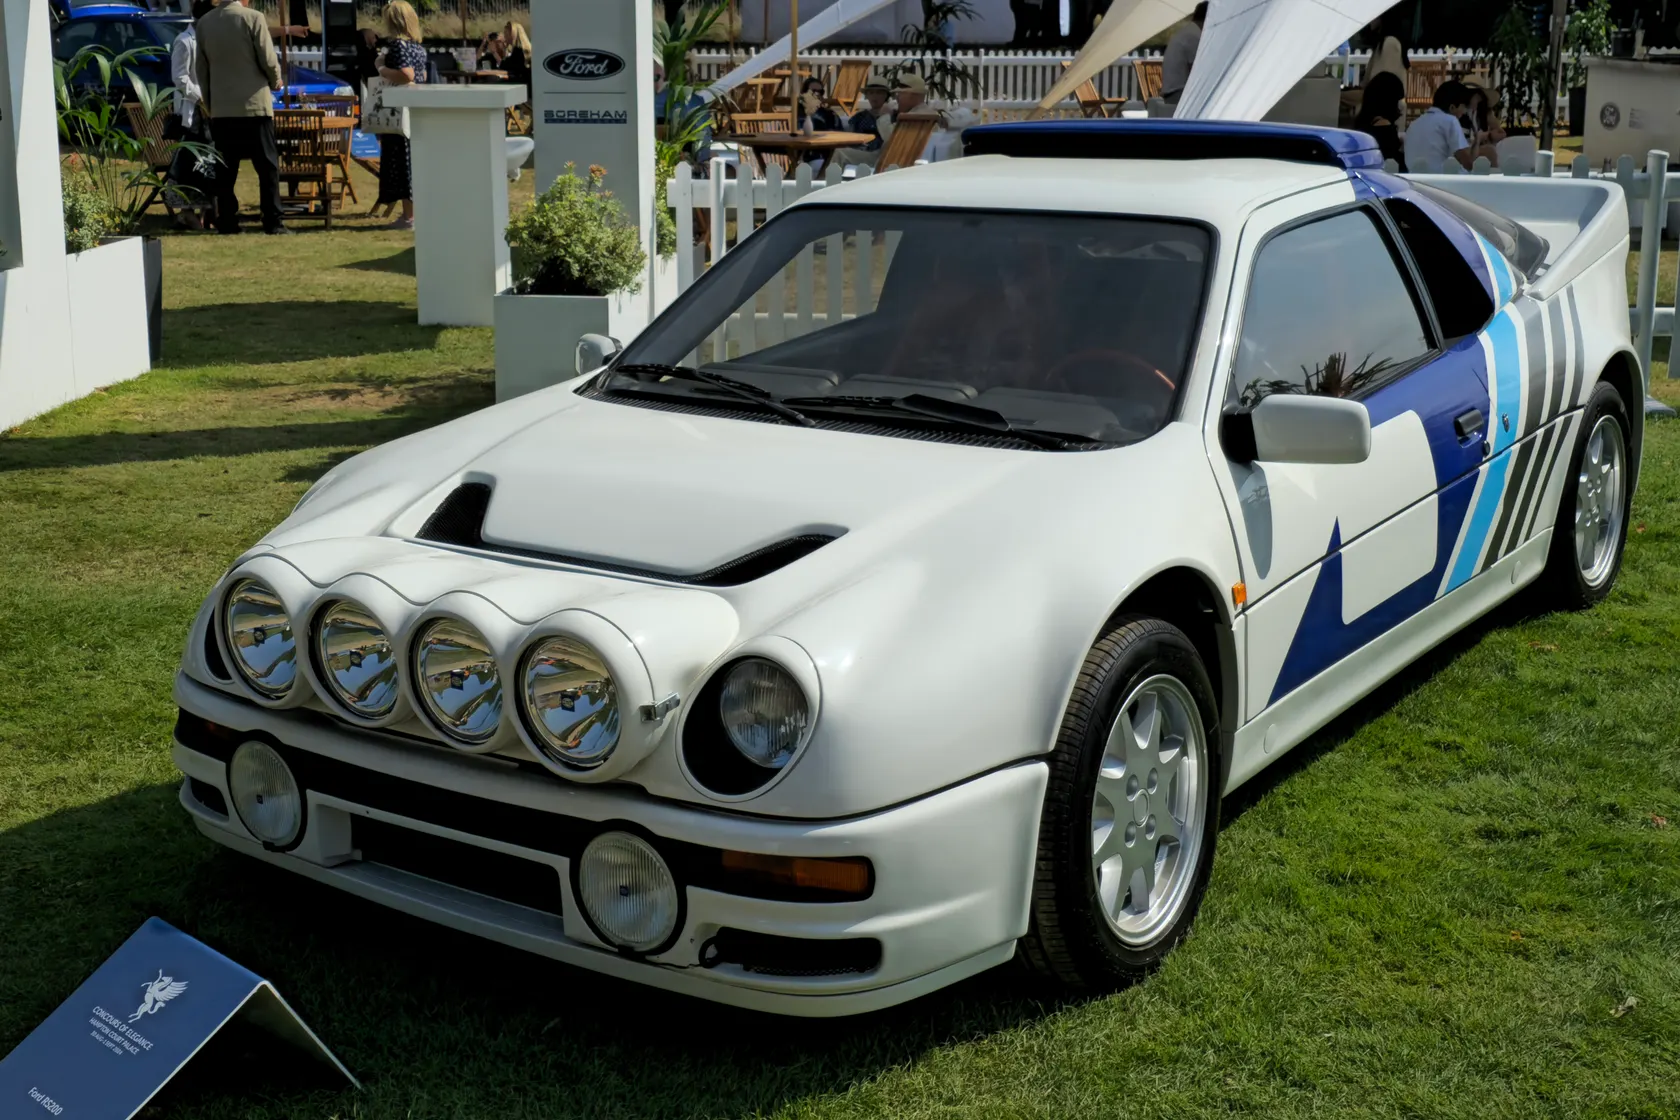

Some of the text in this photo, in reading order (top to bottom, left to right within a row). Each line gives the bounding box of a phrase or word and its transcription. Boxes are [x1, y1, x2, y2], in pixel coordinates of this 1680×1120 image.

[559, 53, 609, 74] Ford
[543, 109, 628, 119] BOREHAM
[88, 1017, 140, 1055] HAMPTON COURT PALACE
[92, 1005, 154, 1051] CONCOURS OF ELEGANCE
[27, 1086, 64, 1116] Ford RS200
